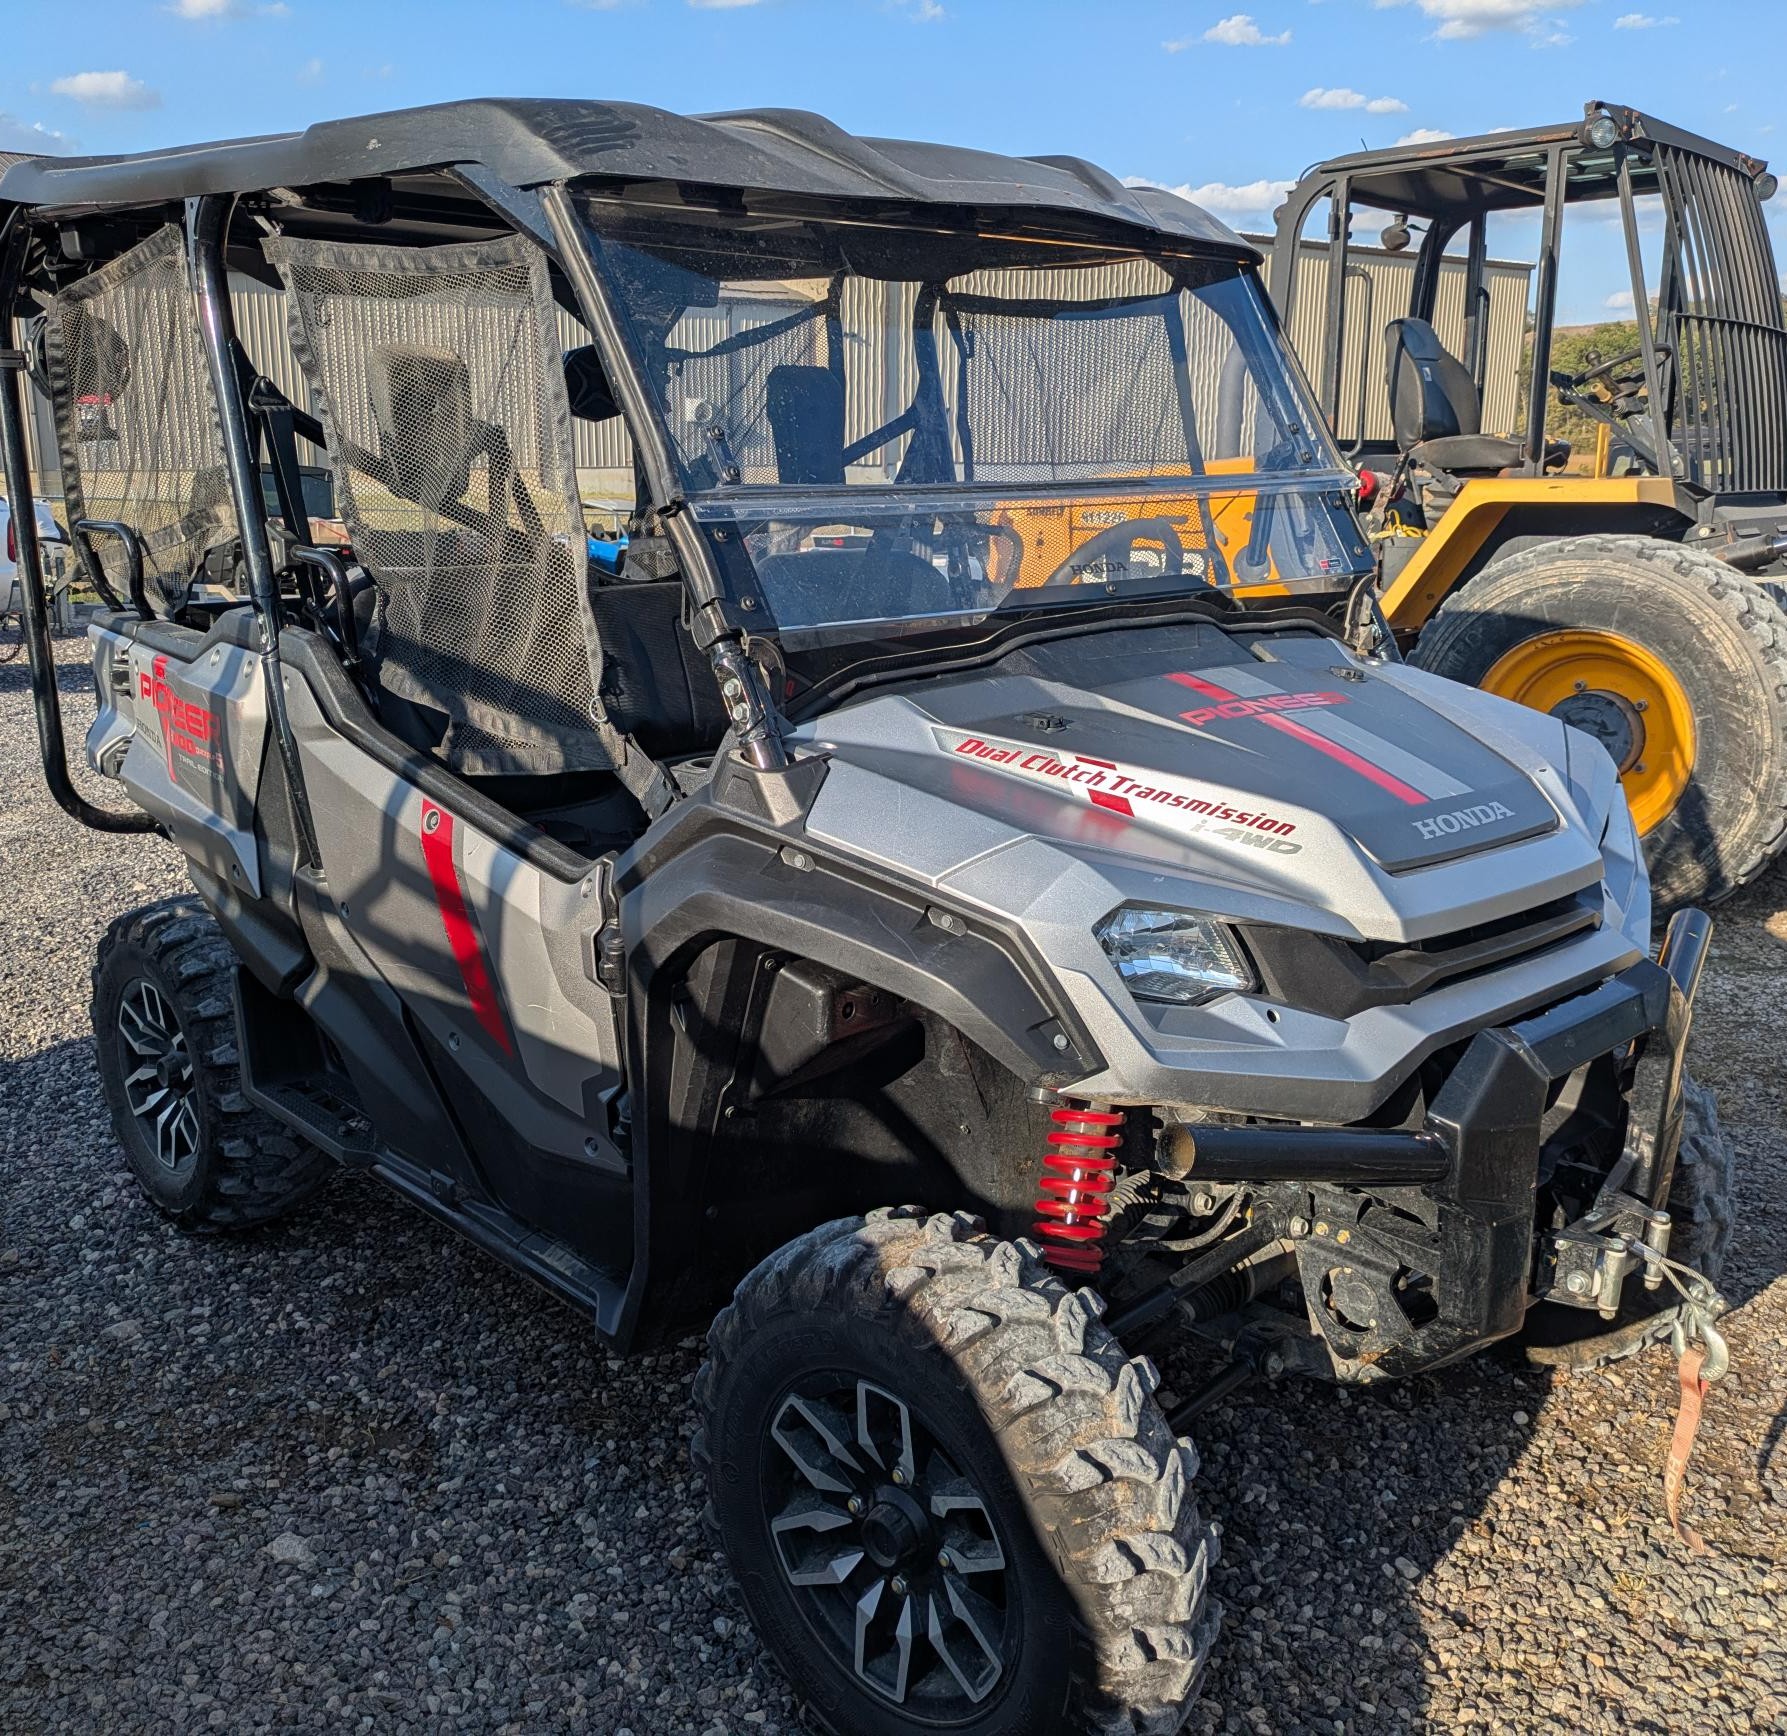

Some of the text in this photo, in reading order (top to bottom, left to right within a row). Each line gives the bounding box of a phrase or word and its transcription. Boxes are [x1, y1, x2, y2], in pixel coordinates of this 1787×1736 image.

[1070, 561, 1128, 575] HONDA
[140, 671, 221, 746] PIONEER
[1178, 691, 1352, 727] PIONEER
[137, 717, 162, 748] HONDA
[954, 737, 1297, 836] Dual Clutch Transmission
[1412, 801, 1516, 840] HONDA
